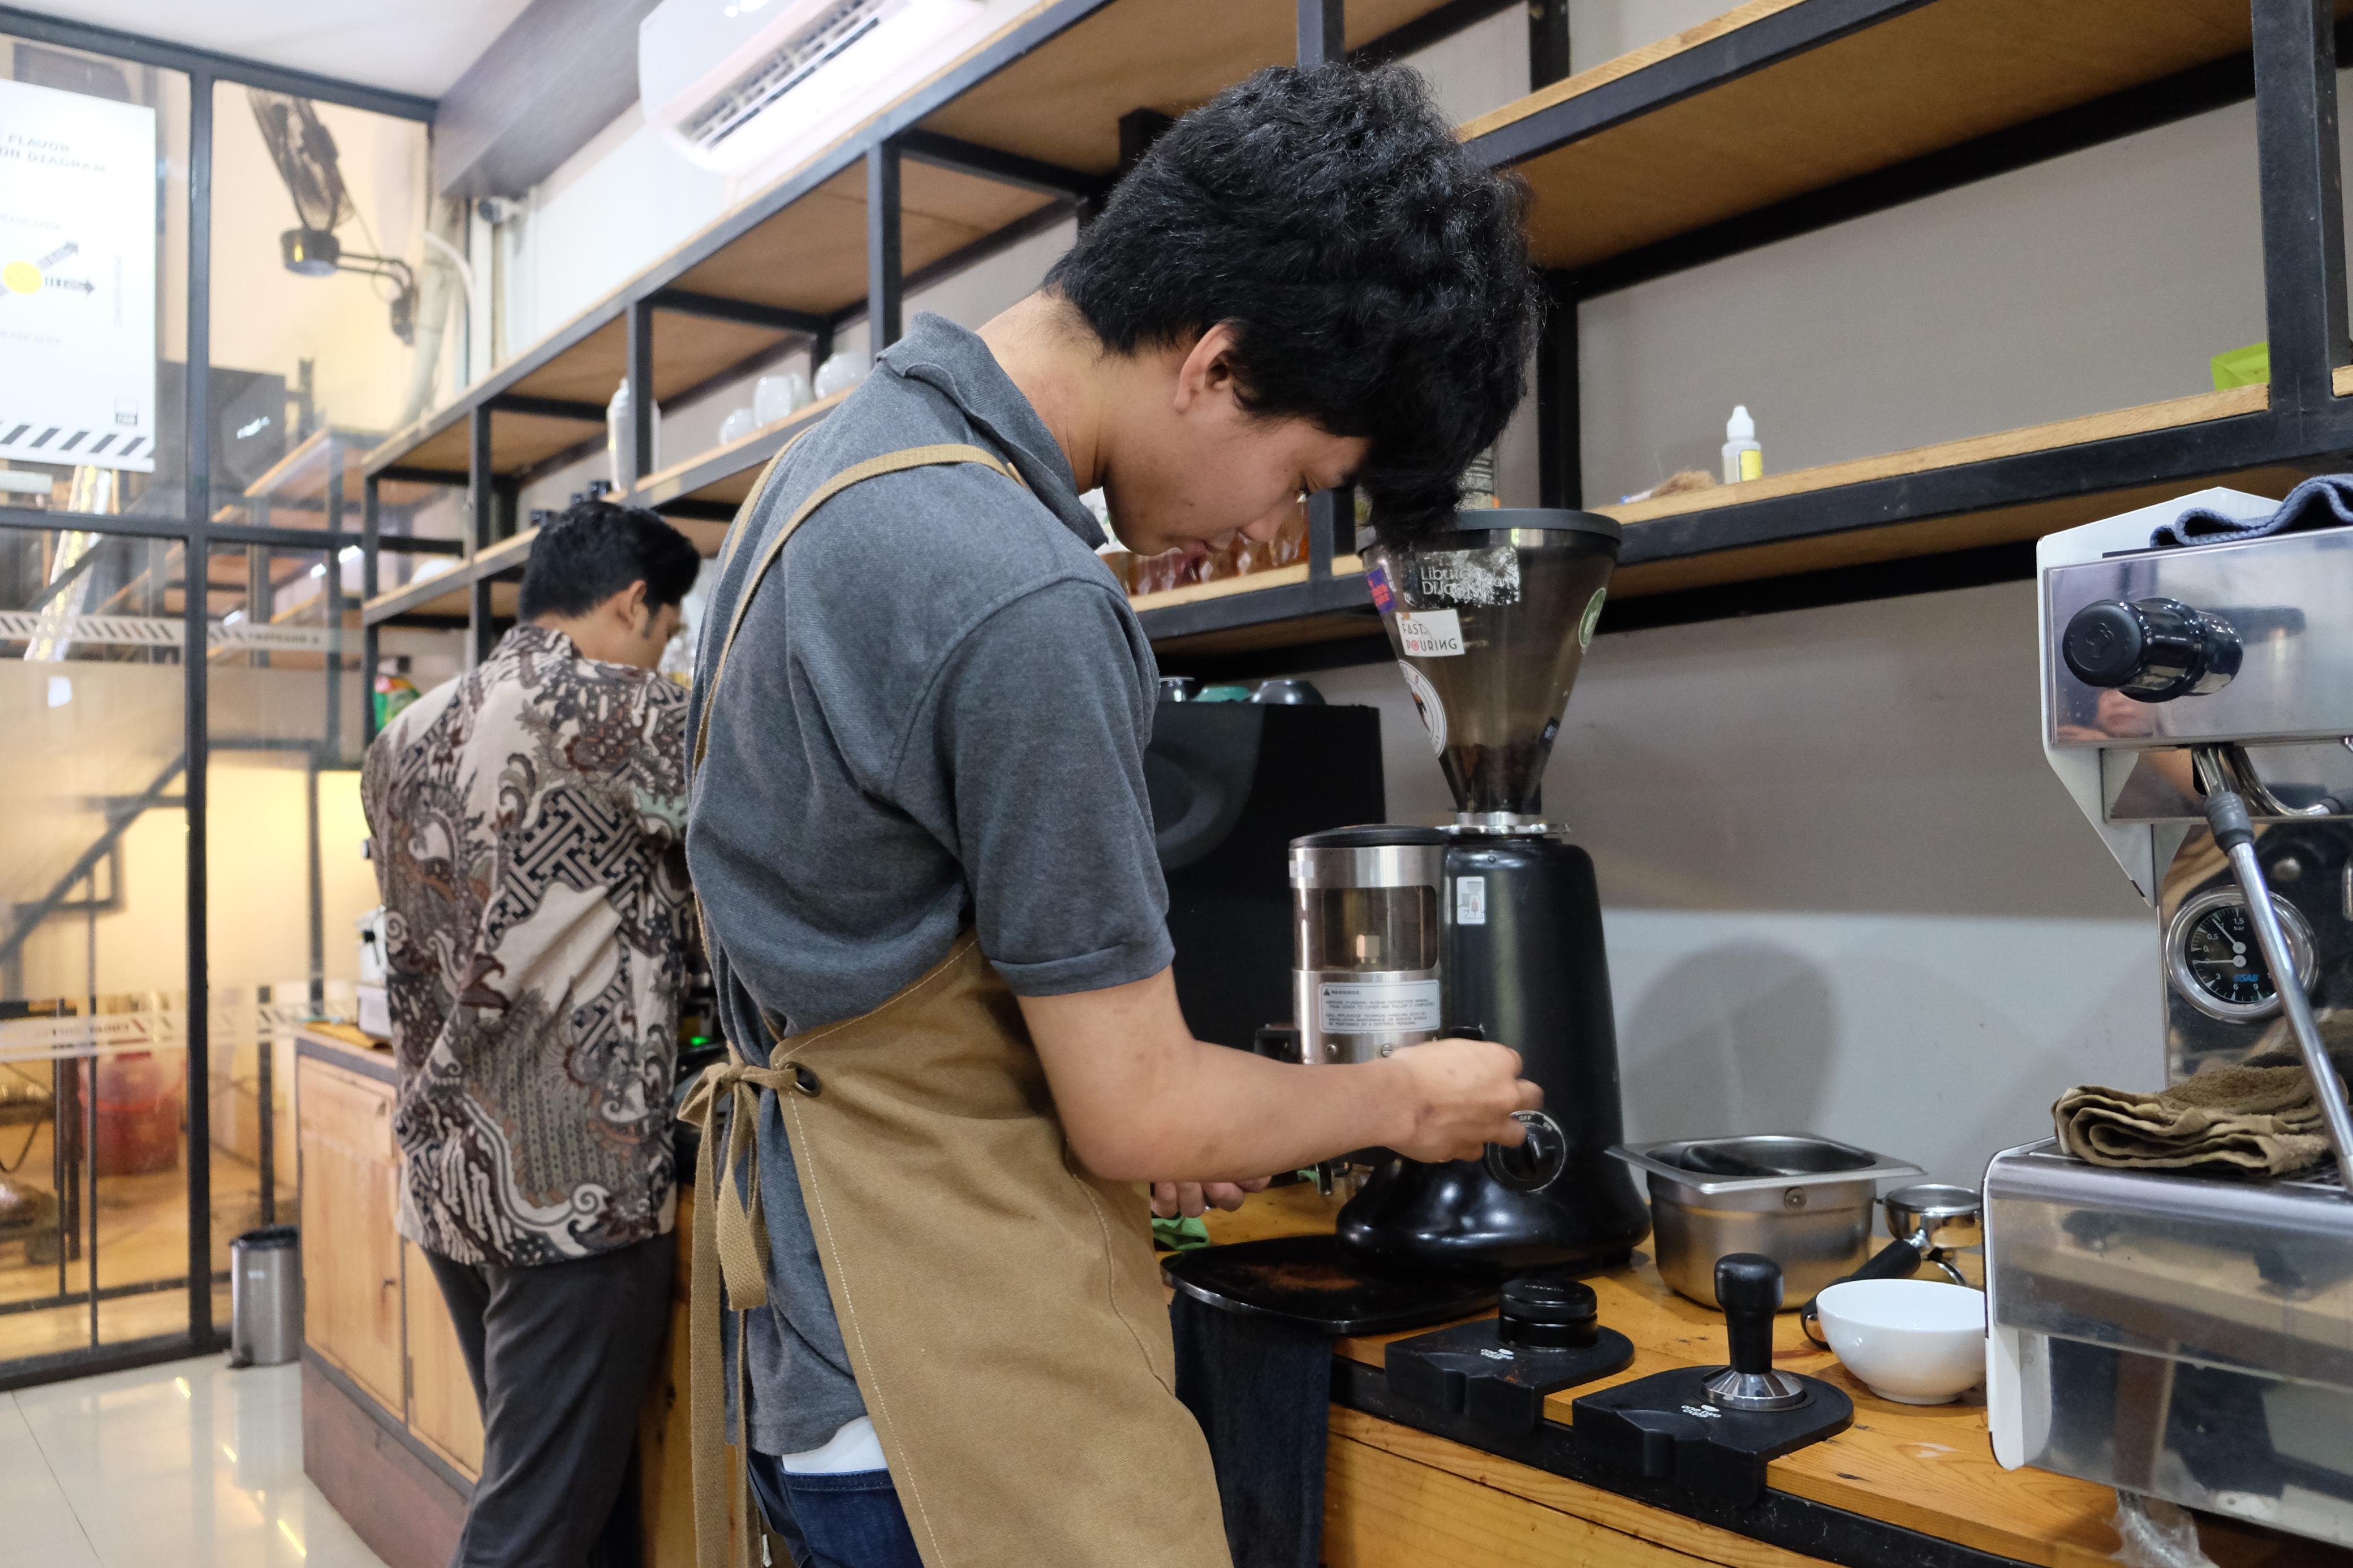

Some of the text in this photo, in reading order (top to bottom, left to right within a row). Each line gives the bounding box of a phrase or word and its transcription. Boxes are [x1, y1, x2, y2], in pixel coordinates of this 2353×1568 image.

[1402, 624, 1423, 634] FAST
[1406, 638, 1458, 651] POURING
[1542, 1122, 1553, 1131] ON
